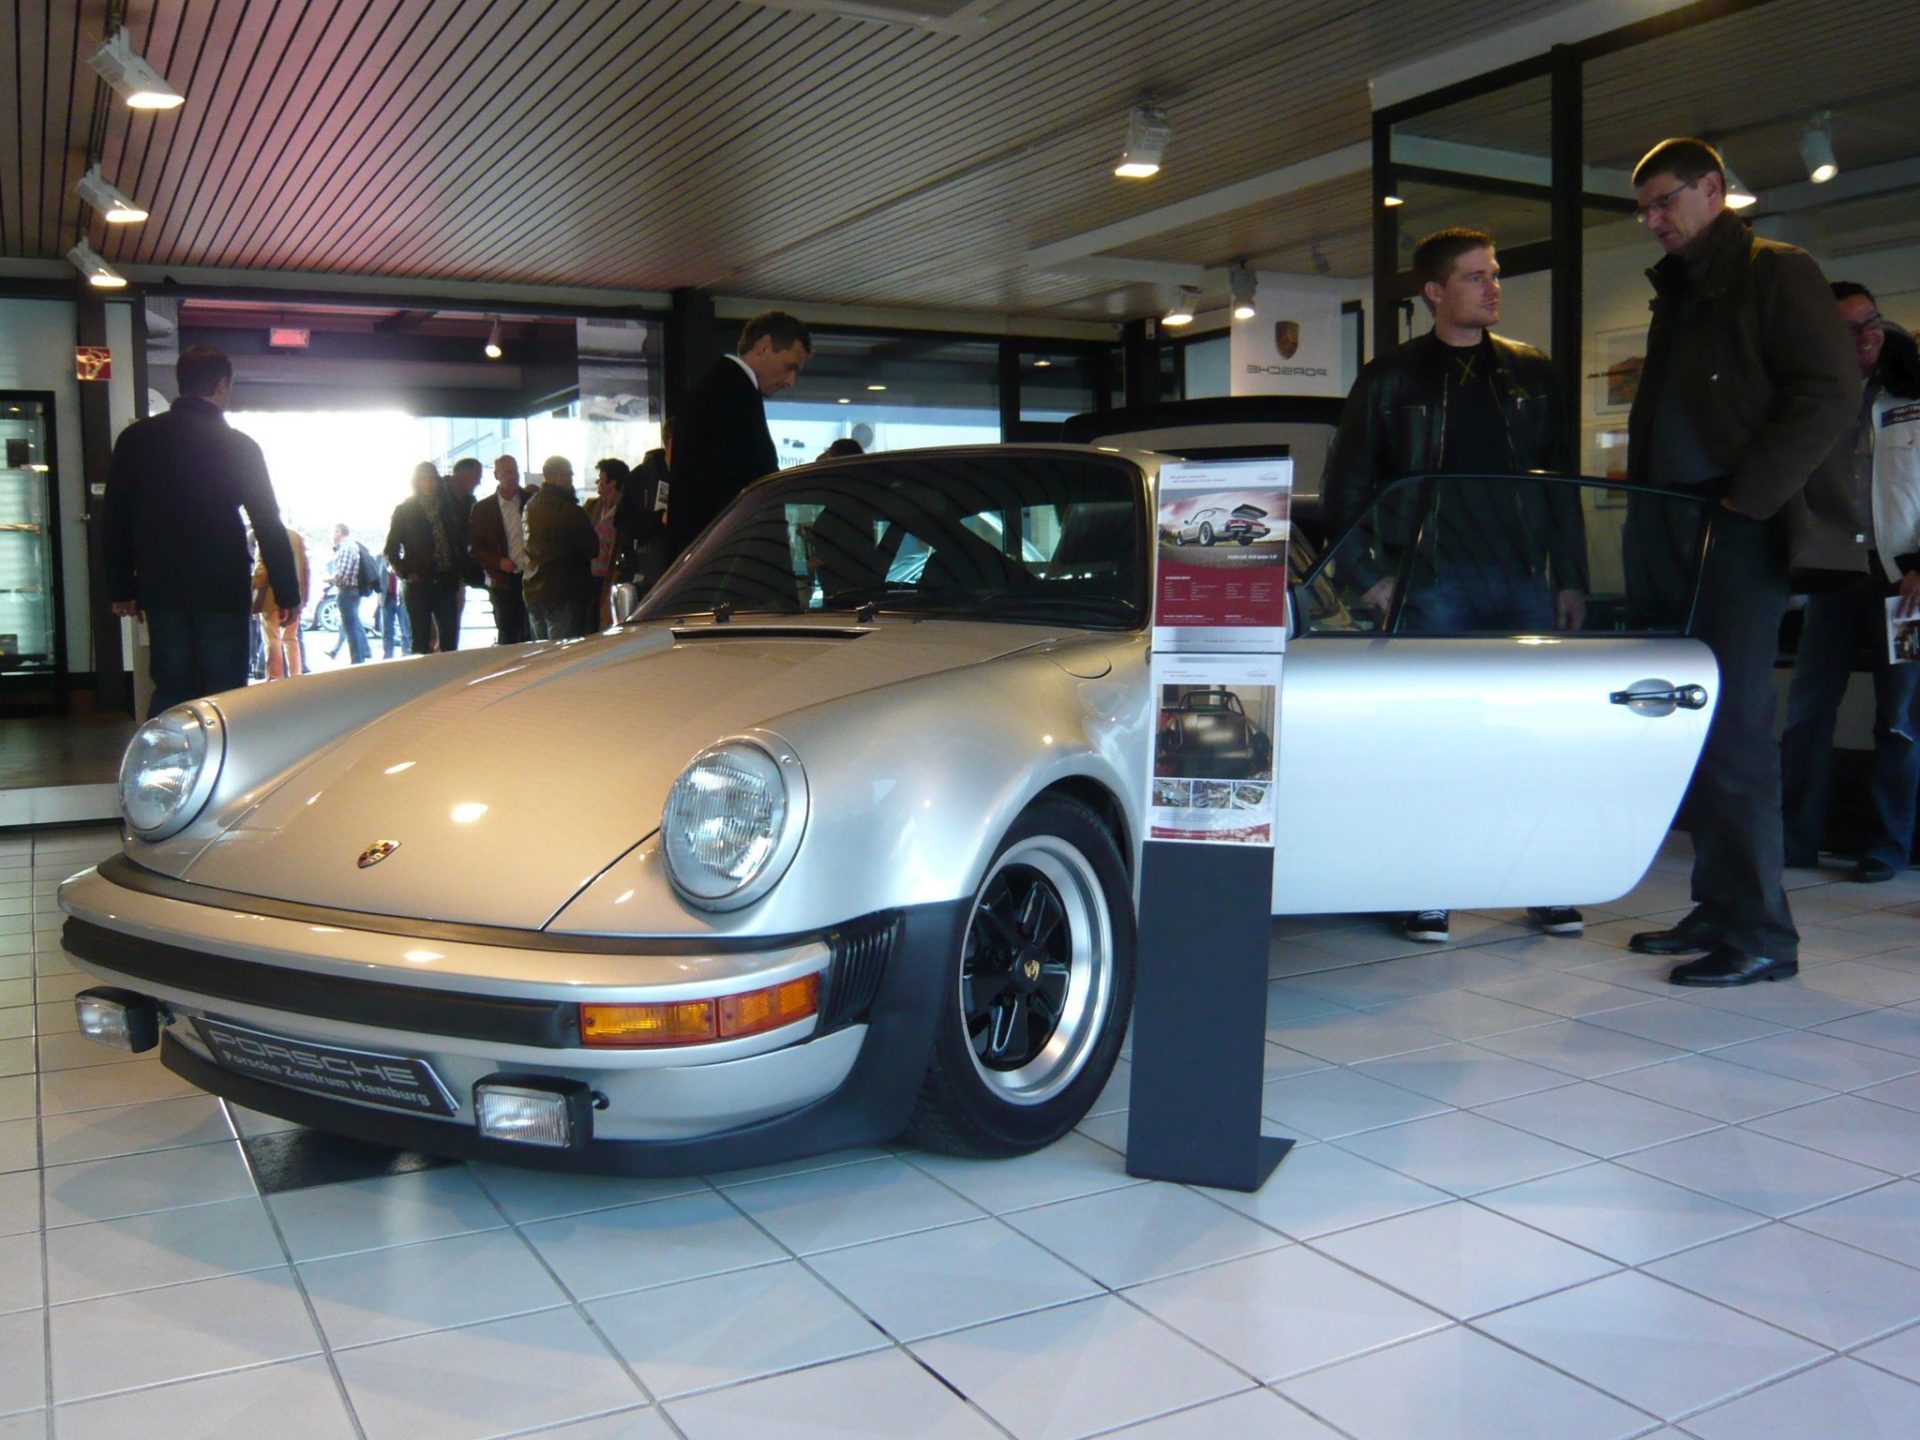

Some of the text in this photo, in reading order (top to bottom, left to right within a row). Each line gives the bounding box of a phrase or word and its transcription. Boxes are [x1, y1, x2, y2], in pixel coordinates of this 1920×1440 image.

[208, 1029, 419, 1086] PORSCHE
[221, 1049, 432, 1107] Porsche Zentrum Hamburg
